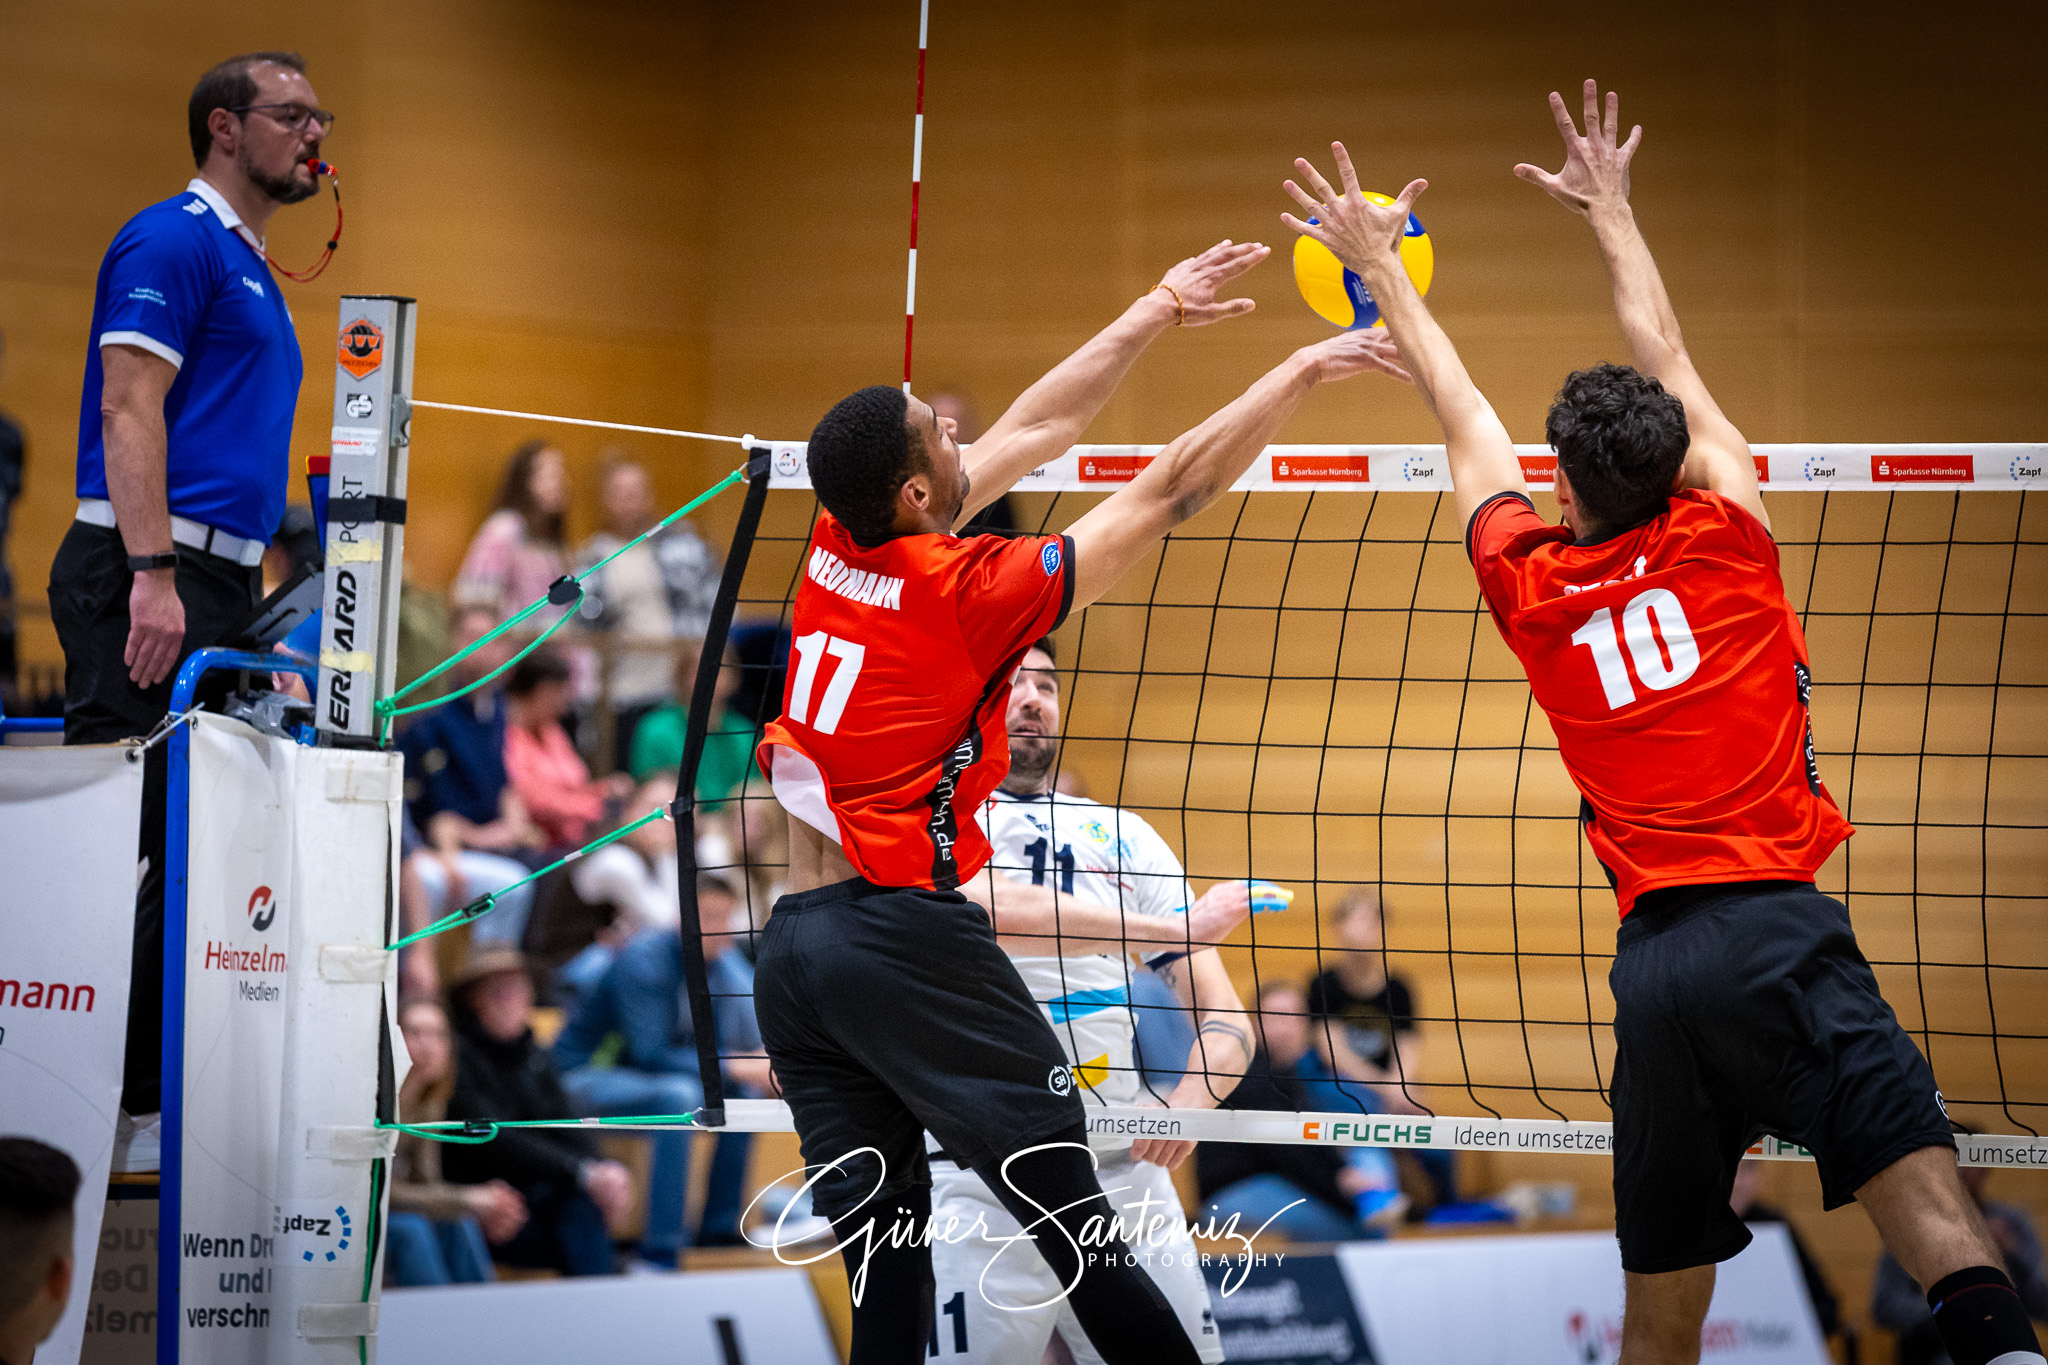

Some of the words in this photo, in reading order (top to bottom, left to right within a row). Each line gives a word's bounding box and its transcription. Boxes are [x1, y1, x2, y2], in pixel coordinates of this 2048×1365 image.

[1098, 467, 1133, 477] Sparkasse
[1292, 467, 1327, 477] Sparkasse
[1329, 467, 1363, 477] Nürnberg
[1412, 468, 1434, 477] Zapf
[1813, 468, 1836, 478] Zapf
[1892, 467, 1930, 477] Sparkasse
[1931, 467, 1967, 477] Nürnberg
[2018, 467, 2042, 477] Zapf
[807, 545, 905, 611] NEUMANN
[329, 569, 357, 731] ERARD
[1570, 587, 1701, 711] 10
[788, 629, 866, 735] 17
[1024, 837, 1075, 896] 11
[204, 941, 287, 973] Heinzelm
[239, 980, 280, 1001] Medien
[1332, 1123, 1432, 1143] FUCHS
[1454, 1125, 1510, 1146] Ideen
[283, 1215, 331, 1236] Zapf
[183, 1233, 244, 1258] Wenn
[218, 1267, 264, 1293] und
